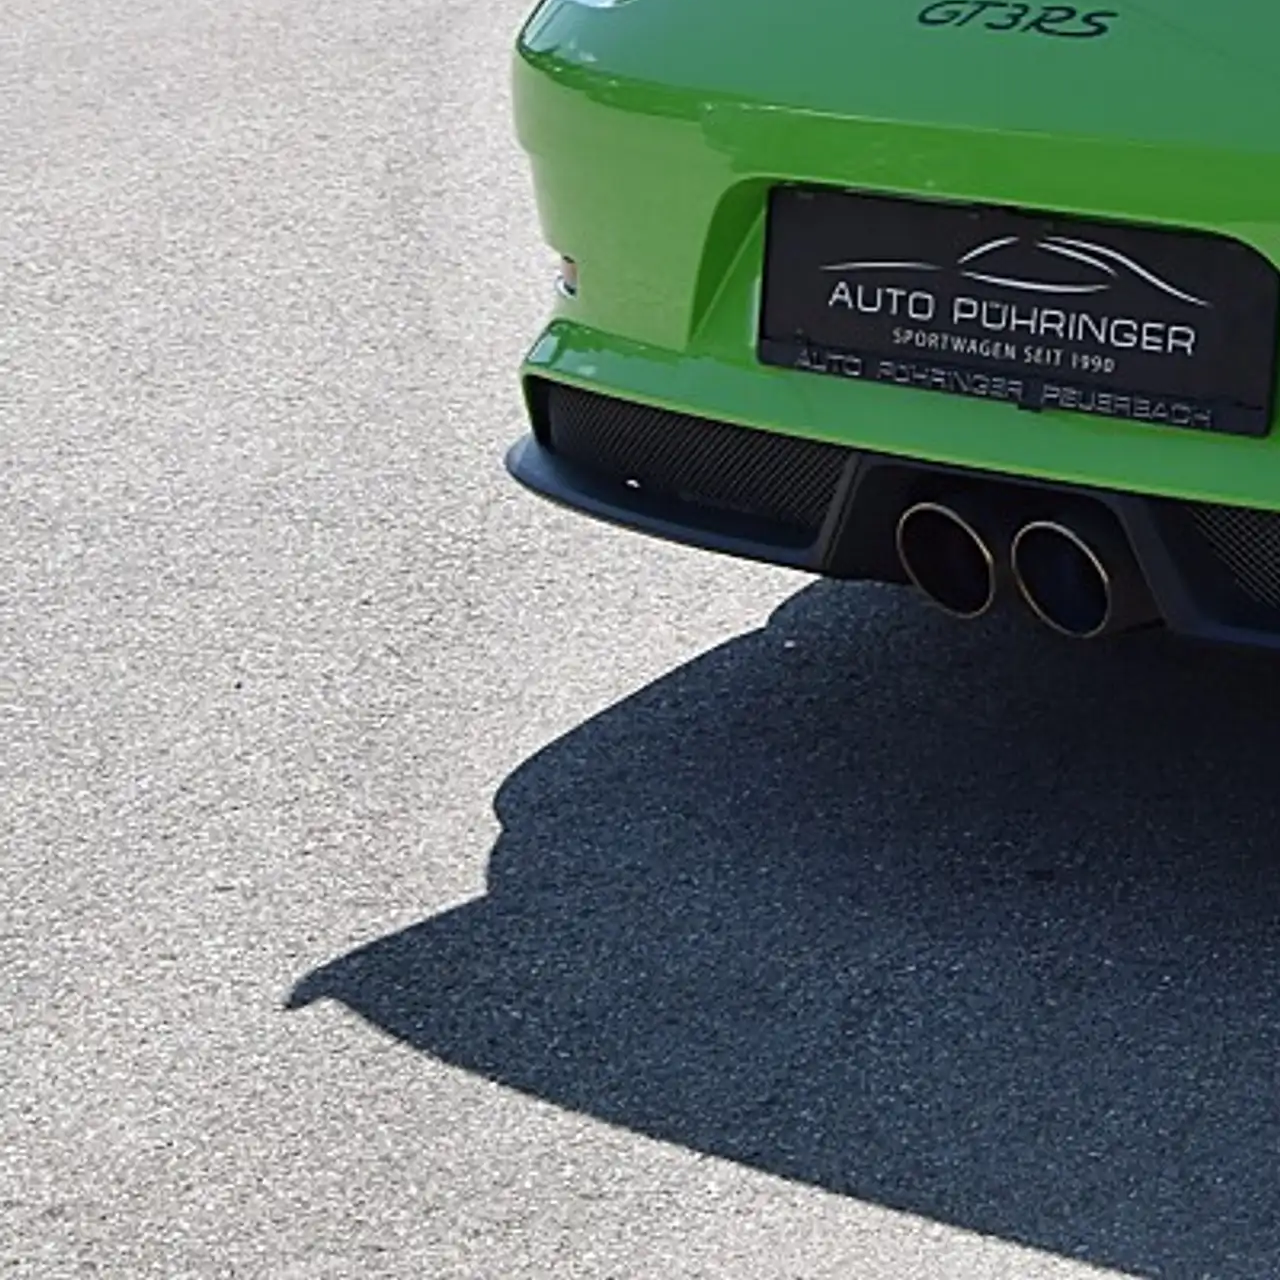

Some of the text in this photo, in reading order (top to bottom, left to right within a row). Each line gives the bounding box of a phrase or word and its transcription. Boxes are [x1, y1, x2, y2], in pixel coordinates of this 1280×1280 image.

[918, 0, 1119, 38] GT3RS
[828, 281, 1196, 356] AUTO PÜHRINGER
[892, 328, 1115, 372] SPORTWAGEN SEIT 1990
